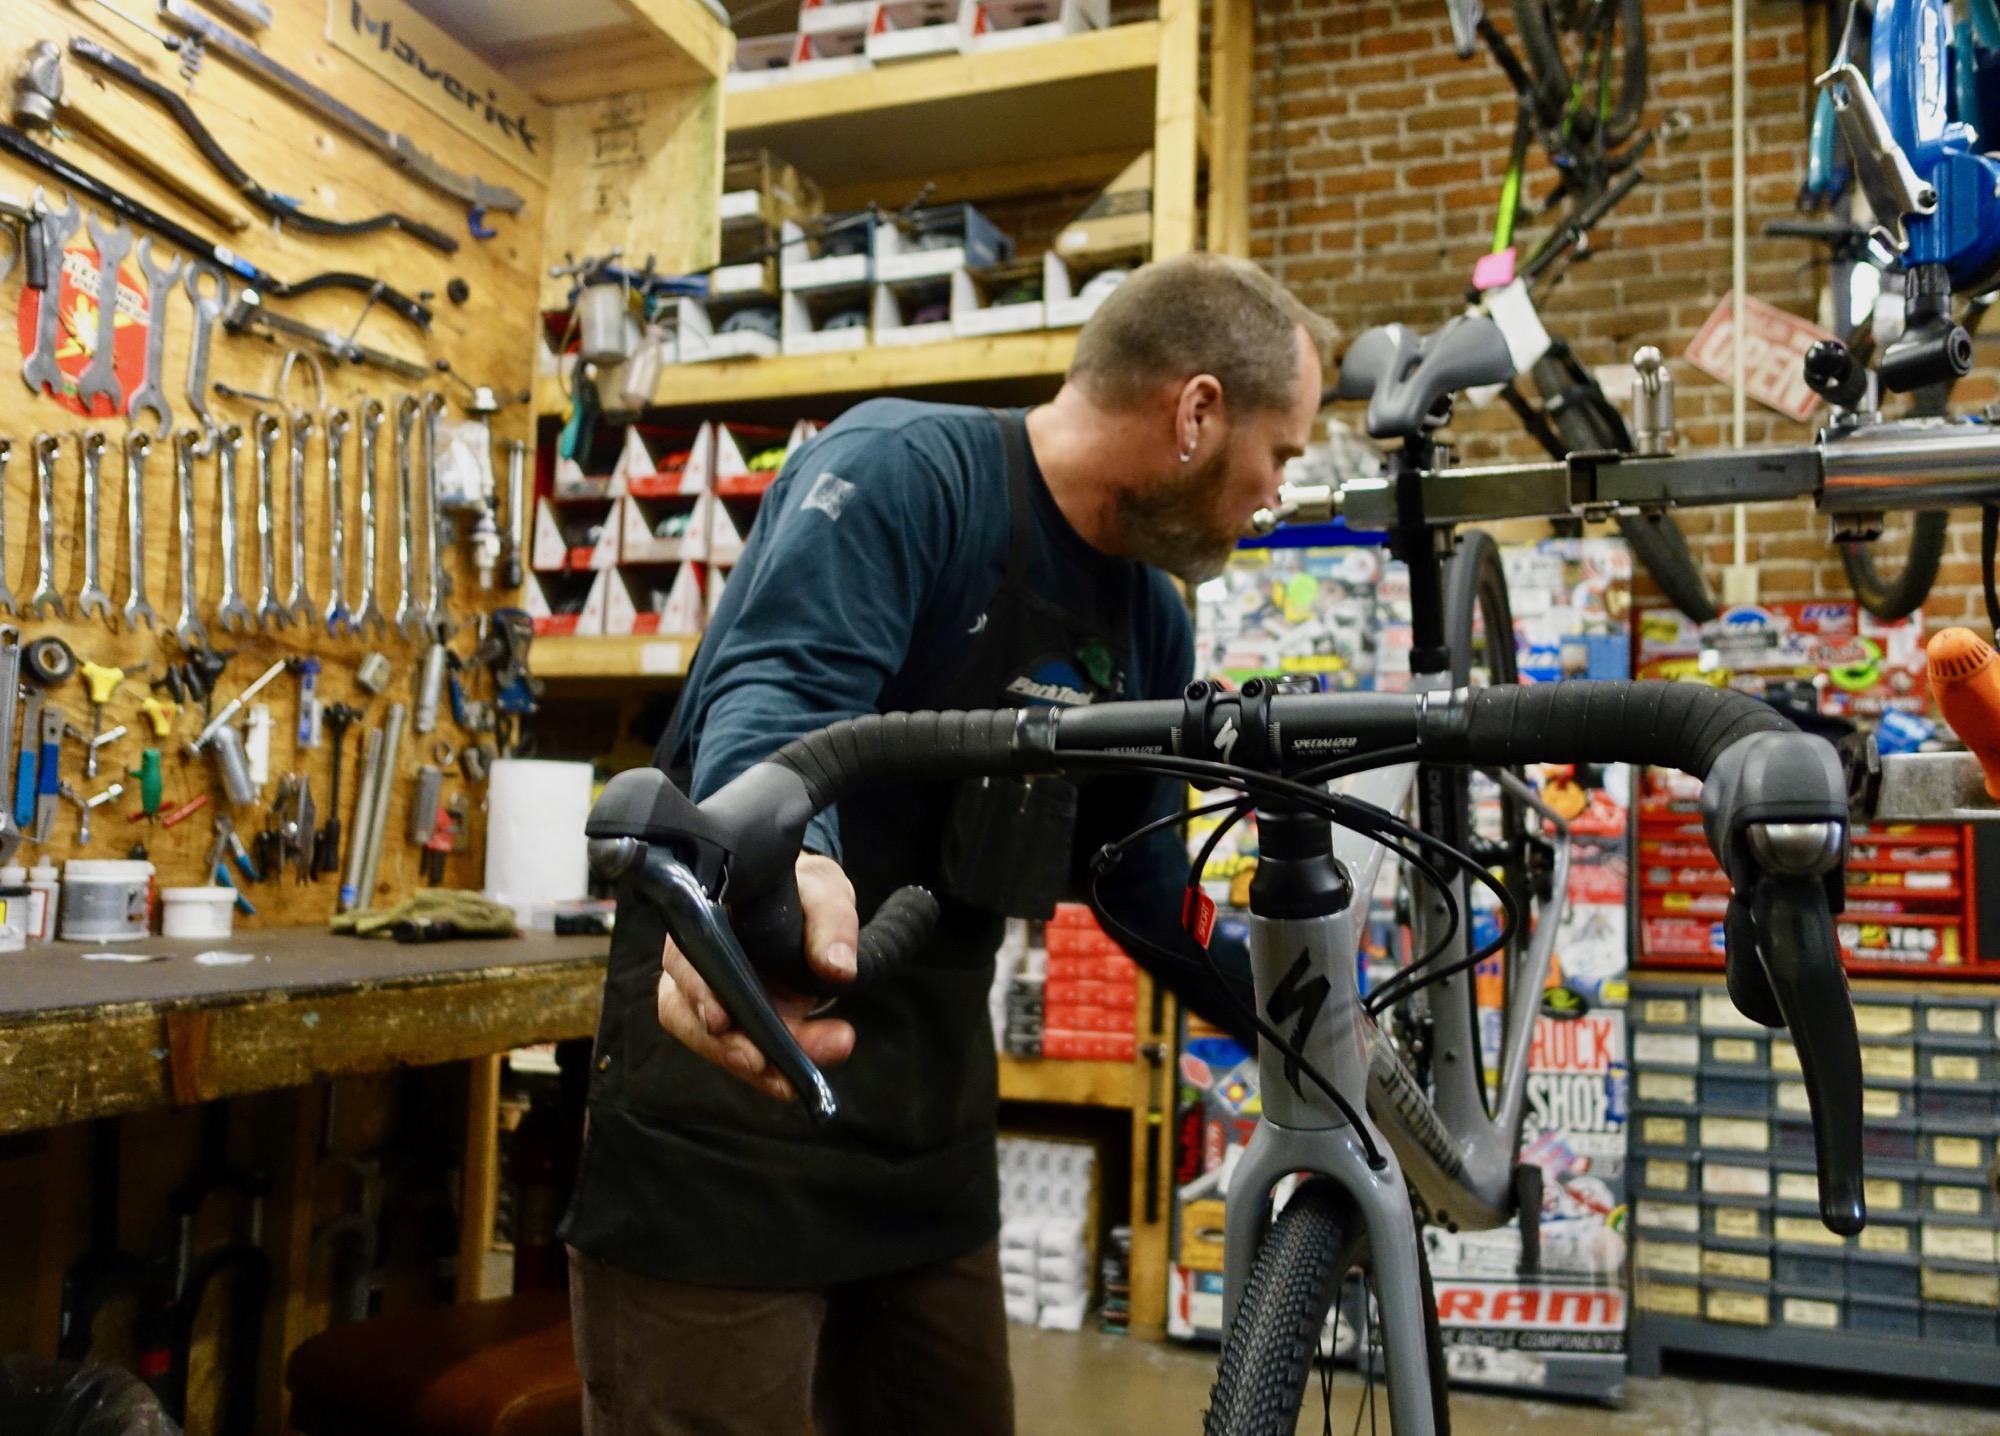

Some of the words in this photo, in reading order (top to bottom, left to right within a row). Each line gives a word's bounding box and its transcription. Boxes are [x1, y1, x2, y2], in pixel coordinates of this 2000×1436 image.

[351, 0, 538, 155] Maverick
[1291, 736, 1358, 749] SPECIALIZED
[1437, 1287, 1622, 1326] RAM
